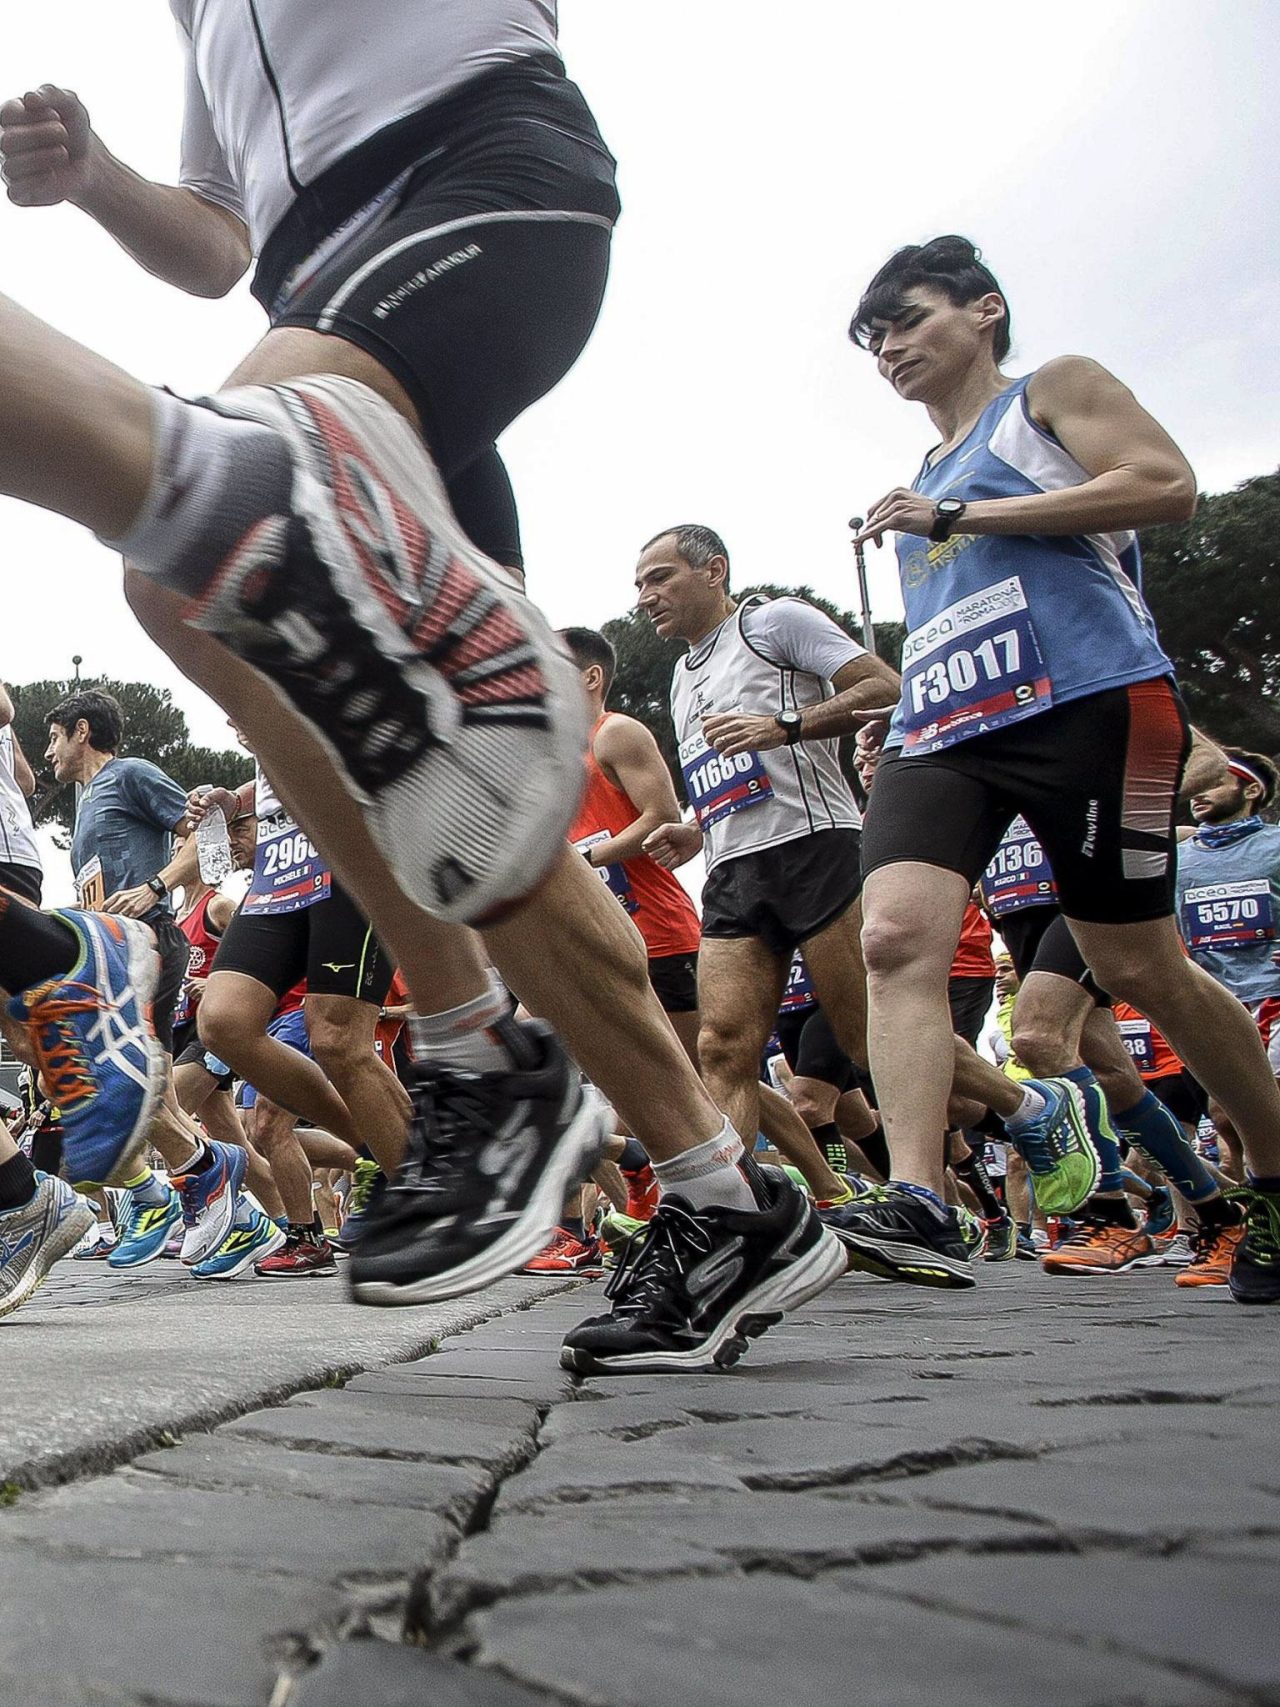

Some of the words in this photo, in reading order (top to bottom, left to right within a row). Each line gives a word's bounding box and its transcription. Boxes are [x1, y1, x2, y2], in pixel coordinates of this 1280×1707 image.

[956, 585, 1019, 617] MARATONA
[910, 629, 1020, 714] F3017
[681, 737, 704, 760] ace
[1197, 898, 1259, 924] 5570
